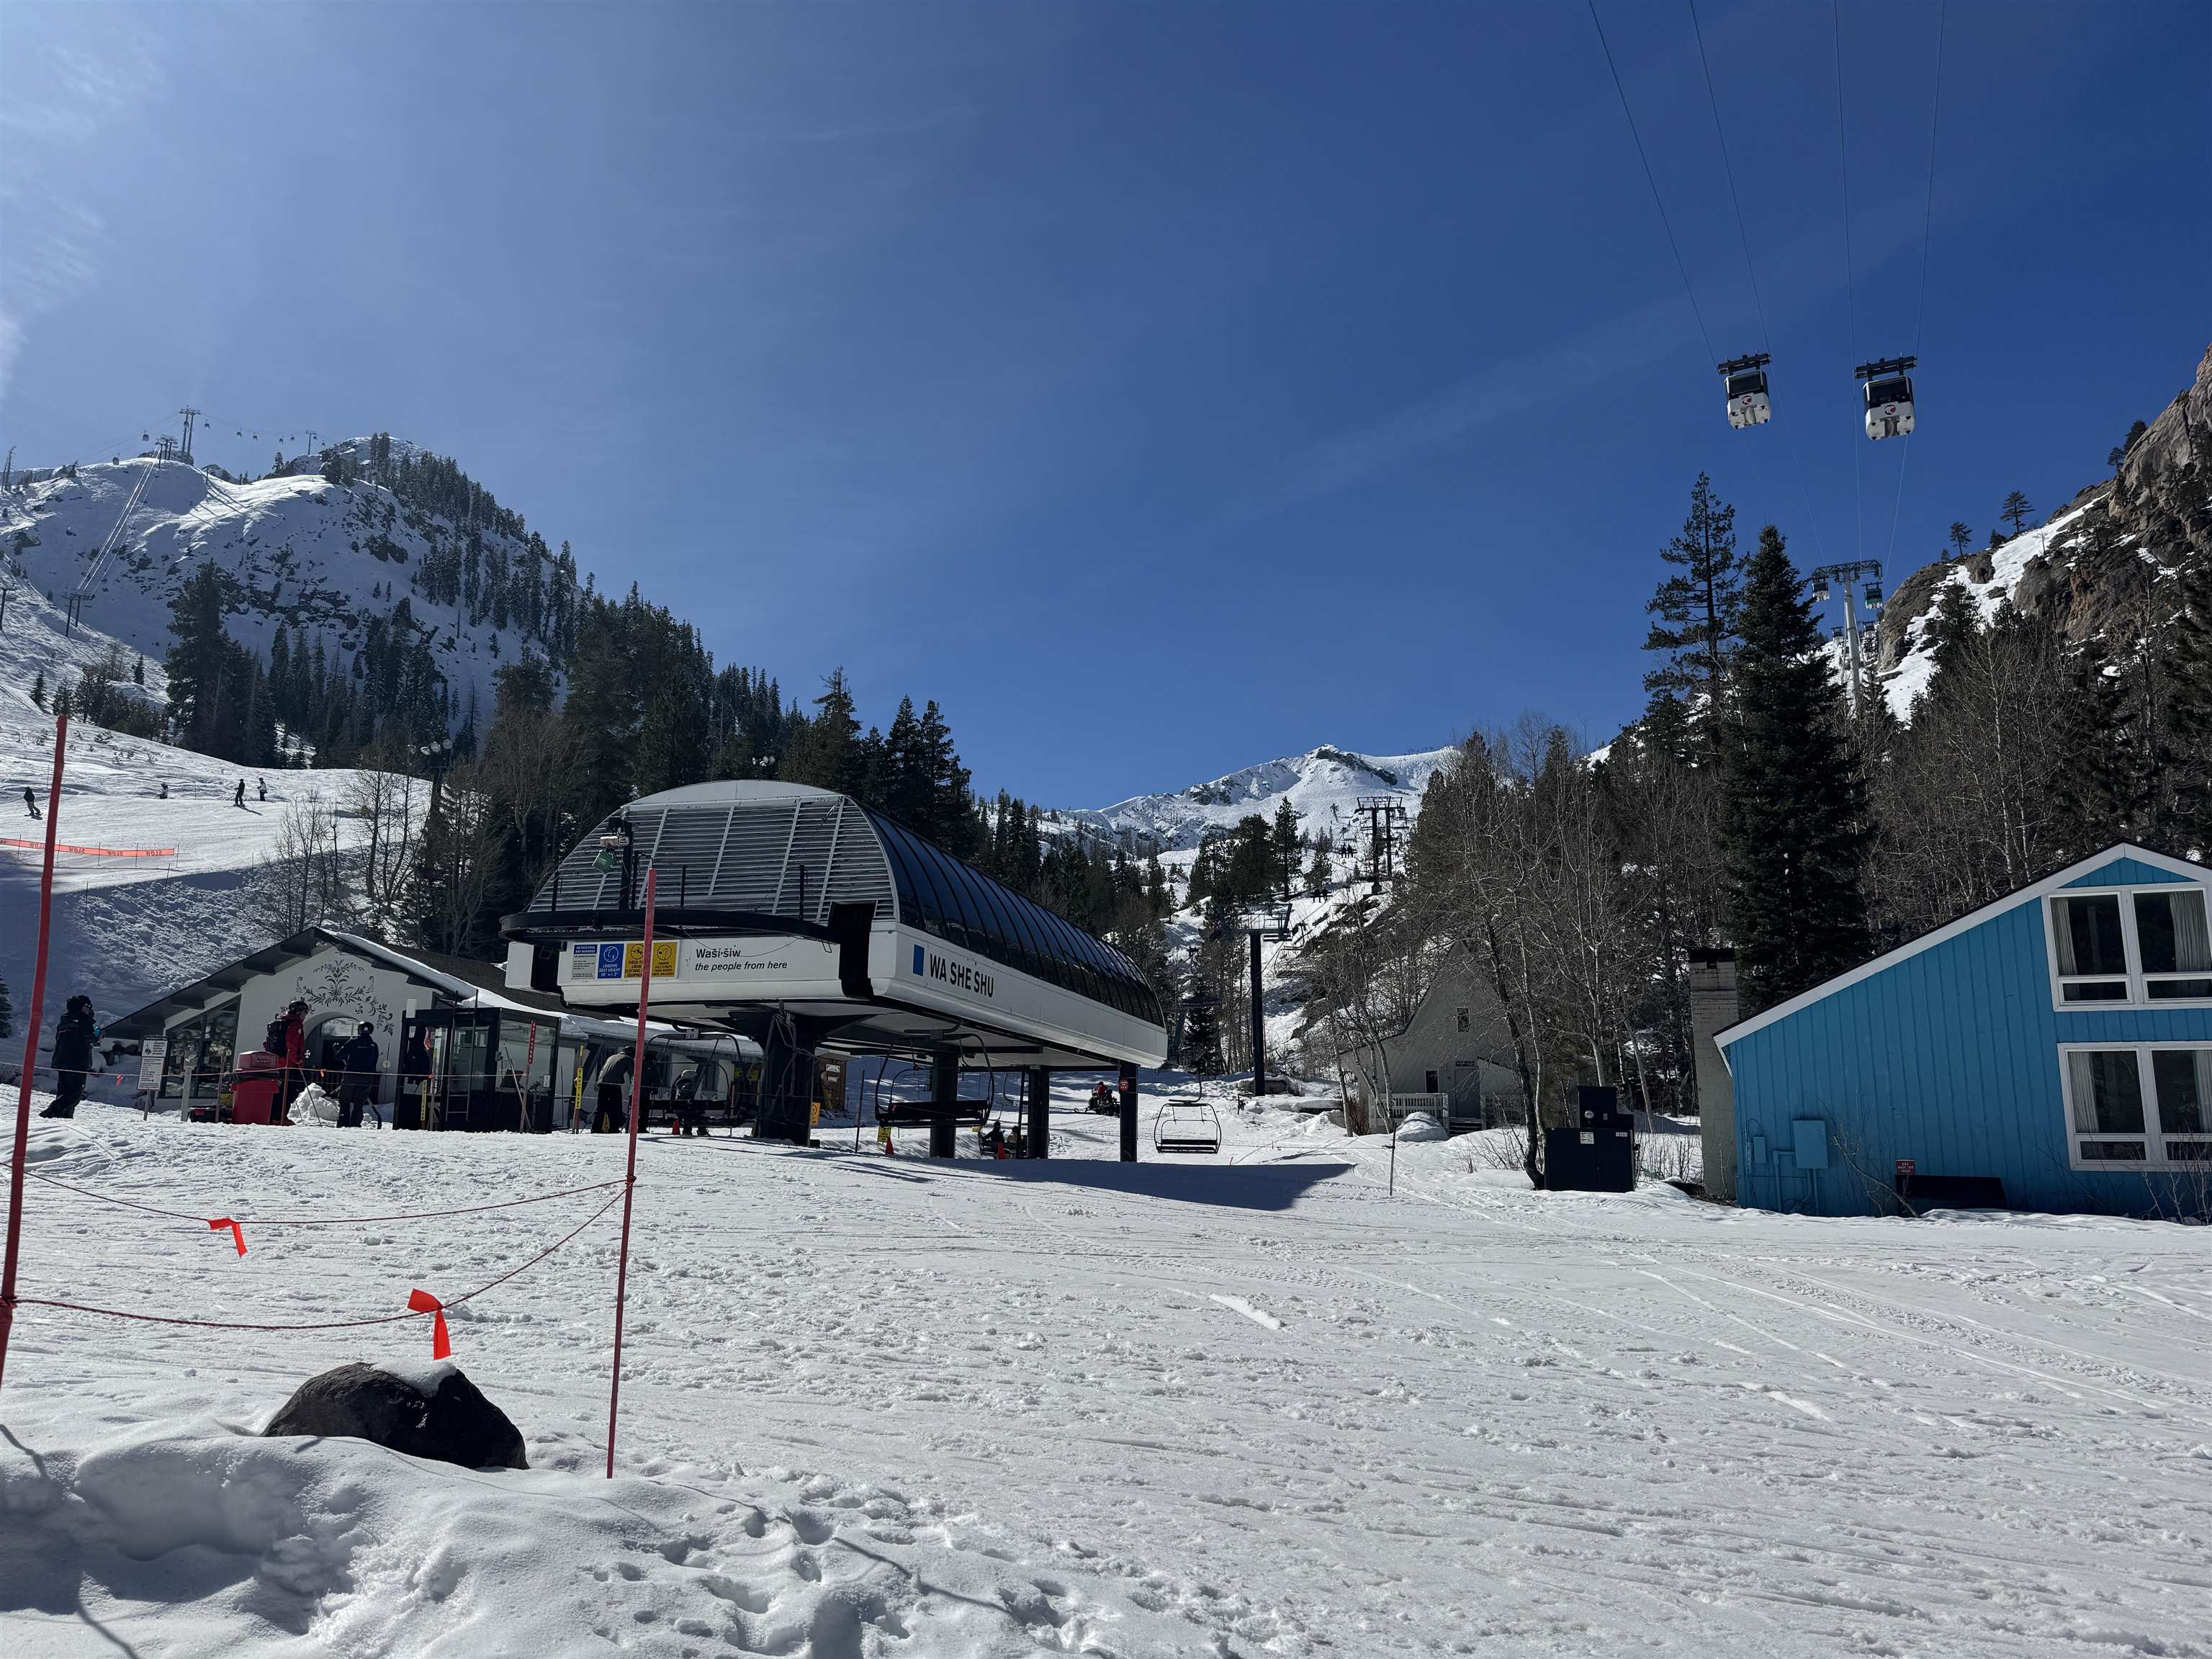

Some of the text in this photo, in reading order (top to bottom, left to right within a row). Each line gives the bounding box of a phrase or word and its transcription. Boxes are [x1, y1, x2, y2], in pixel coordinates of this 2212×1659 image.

[711, 962, 742, 972] people
[767, 961, 788, 969] here
[930, 953, 994, 998] WA SHE SHU
